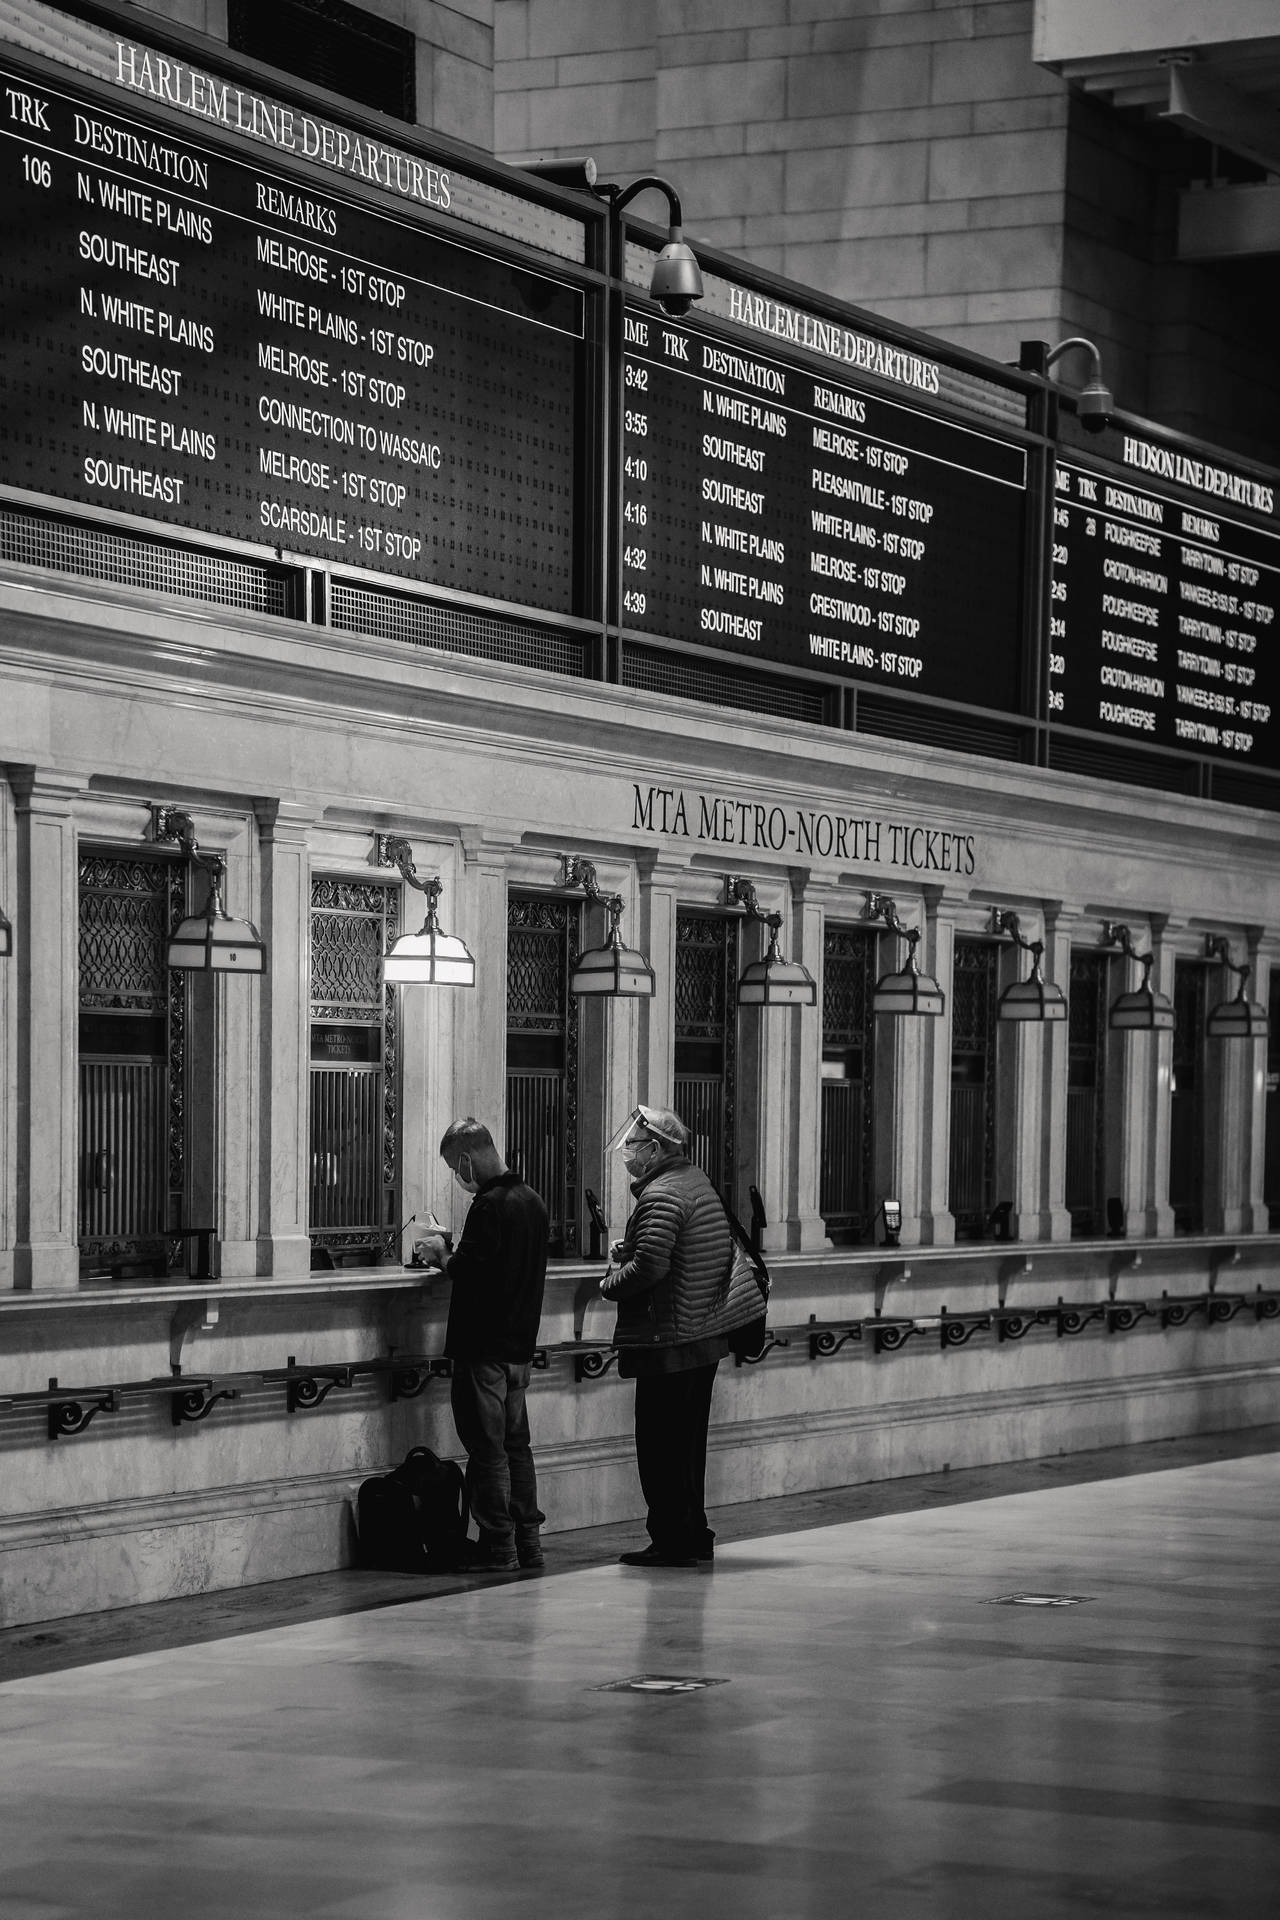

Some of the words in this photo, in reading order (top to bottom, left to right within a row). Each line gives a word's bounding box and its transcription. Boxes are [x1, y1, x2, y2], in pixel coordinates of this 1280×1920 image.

[6, 88, 50, 131] TRK
[116, 42, 229, 123] HARLEM
[236, 90, 295, 148] LINE
[302, 117, 450, 208] DEPARTURES
[23, 155, 51, 187] 106
[74, 114, 208, 190] DESTINATION
[78, 172, 94, 203] N.
[99, 180, 152, 223] WHITE
[157, 200, 212, 243] PLAINS
[256, 183, 336, 235] REMARKS
[80, 231, 179, 286] SOUTHEAST
[258, 236, 327, 283] MELROSE
[341, 267, 365, 295] 1ST
[369, 276, 405, 308] STOP
[81, 288, 97, 317] N.
[102, 294, 154, 335] WHITE
[159, 312, 213, 352] PLAINS
[258, 289, 305, 328] WHITE
[309, 307, 357, 345] PLAINS
[370, 328, 394, 355] 1ST
[398, 337, 433, 367] STOP
[624, 318, 648, 346] IME
[729, 288, 800, 342] HARLEM
[802, 316, 840, 357] LINE
[844, 332, 938, 393] DEPARTURES
[662, 331, 689, 361] TRK
[82, 345, 181, 396] SOUTHEAST
[259, 343, 328, 387] MELROSE
[341, 370, 366, 397] 1ST
[369, 378, 405, 408] STOP
[626, 365, 647, 391] 3:42
[703, 346, 785, 395] DESTINATION
[625, 410, 647, 436] 3:55
[704, 390, 714, 413] N.
[716, 394, 749, 424] WHITE
[751, 406, 786, 437] PLAINS
[814, 386, 865, 423] REMARKS
[84, 401, 99, 429] N.
[104, 406, 156, 444] WHITE
[161, 422, 215, 460] PLAINS
[259, 396, 354, 445] CONNECTION
[357, 424, 376, 451] TO
[380, 430, 440, 469] WASSAIC
[703, 435, 765, 472] SOUTHEAST
[813, 427, 859, 460] MELROSE
[866, 446, 882, 467] 1ST
[882, 450, 908, 475] STOP
[85, 457, 183, 504] SOUTHEAST
[260, 448, 329, 489] MELROSE
[342, 472, 366, 498] 1ST
[370, 479, 406, 507] STOP
[625, 456, 647, 481] 4:10
[1078, 477, 1097, 501] TRK
[1124, 437, 1176, 478] HUDSON
[1176, 456, 1203, 488] LINE
[1204, 466, 1273, 513] DEPARTURES
[624, 501, 647, 525] 4:16
[702, 478, 765, 514] SOUTHEAST
[813, 469, 885, 510] PLEASANTVILLE
[891, 495, 907, 516] 1ST
[907, 499, 933, 523] STOP
[1105, 487, 1163, 523] DESTINATION
[261, 501, 345, 543] SCARSDALE
[358, 526, 382, 551] 1ST
[385, 532, 421, 560] STOP
[702, 521, 712, 543] N.
[715, 525, 747, 553] WHITE
[747, 534, 784, 563] PLAINS
[812, 510, 842, 538] WHITE
[844, 520, 876, 548] PLAINS
[883, 533, 899, 553] 1ST
[900, 537, 925, 560] STOP
[1182, 512, 1219, 541] REMARKS
[624, 546, 646, 570] 4:32
[811, 552, 856, 583] MELROSE
[863, 568, 880, 588] 1ST
[881, 572, 906, 595] STOP
[624, 591, 645, 614] 4:39
[702, 565, 712, 587] N.
[714, 568, 747, 595] WHITE
[749, 577, 783, 605] PLAINS
[701, 608, 762, 640] SOUTHEAST
[810, 593, 871, 626] CRESTWOOD
[878, 612, 894, 632] 1ST
[894, 615, 919, 638] STOP
[809, 634, 840, 660] WHITE
[841, 642, 873, 668] PLAINS
[881, 652, 897, 672] 1ST
[898, 656, 922, 677] STOP
[632, 785, 689, 836] MTA
[698, 796, 881, 861] METRO-NORTH
[889, 825, 974, 875] TICKETS
[229, 953, 237, 962] 10
